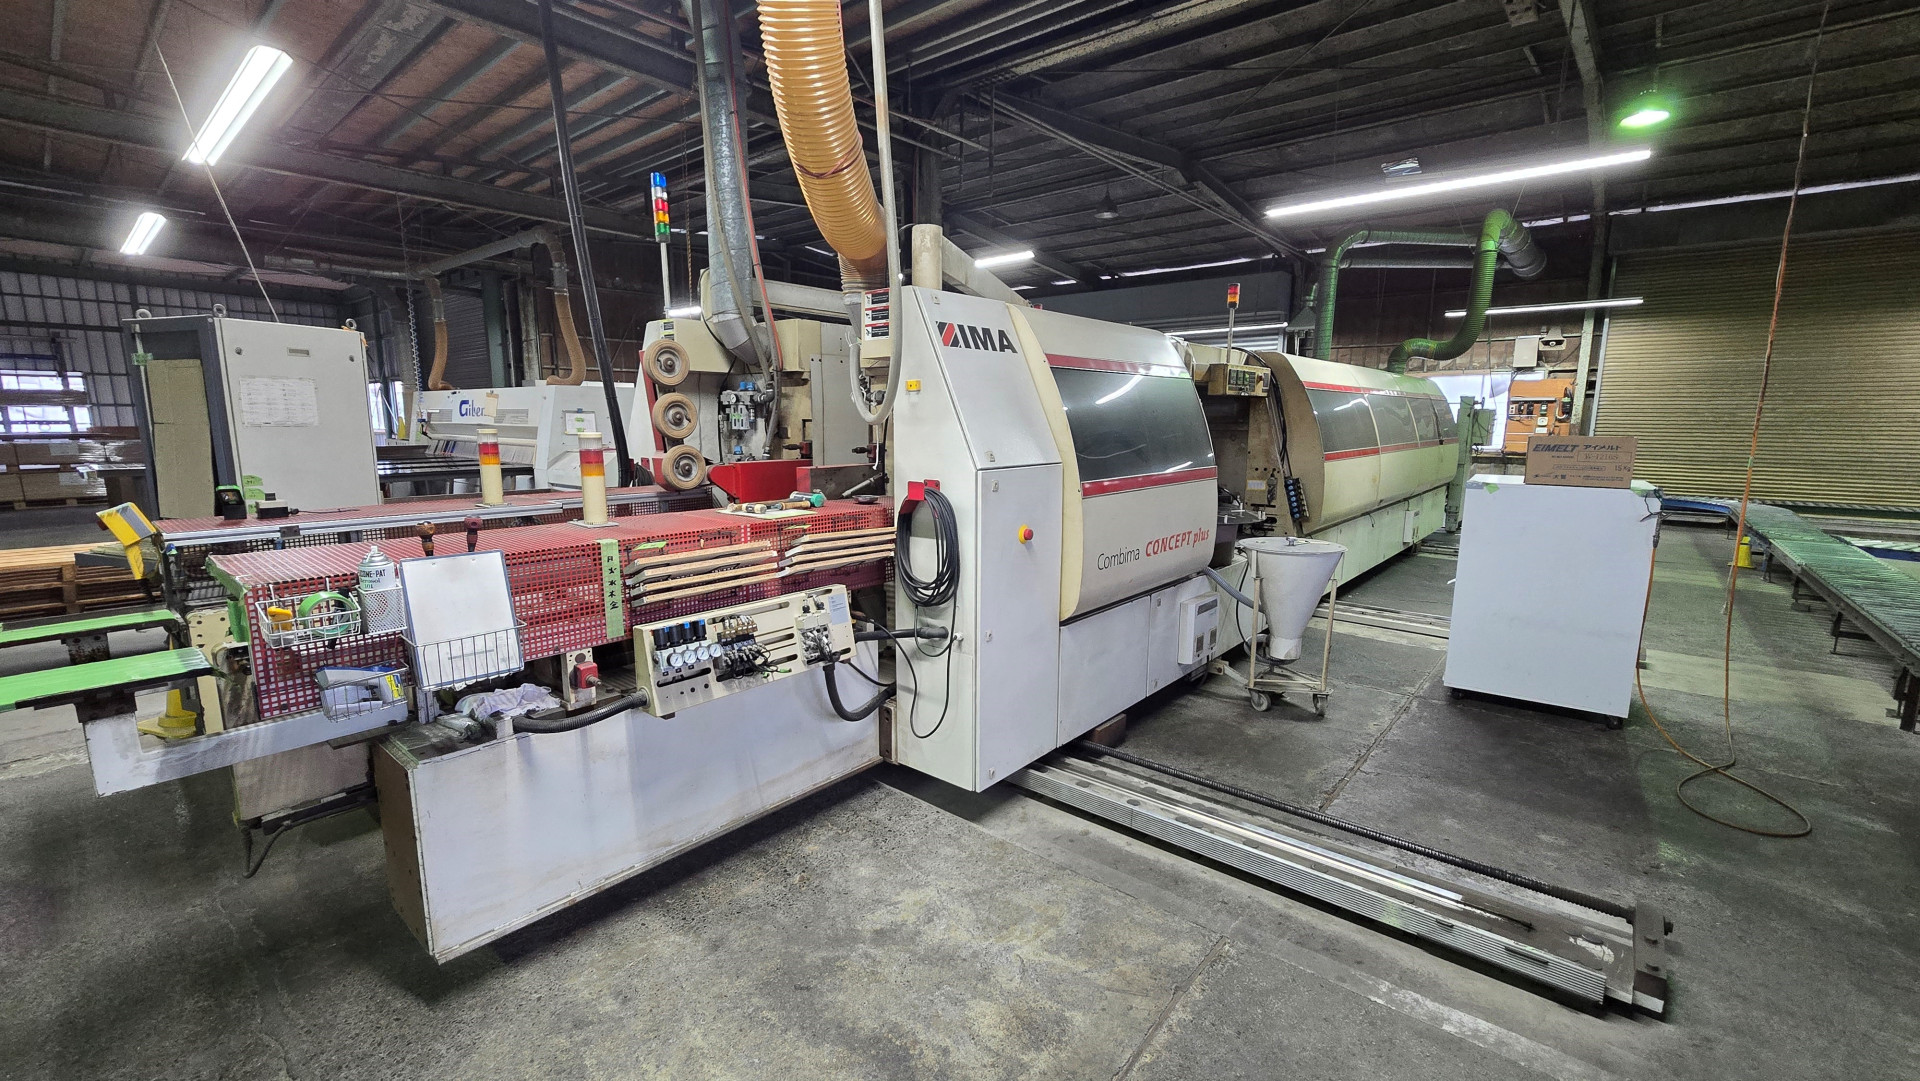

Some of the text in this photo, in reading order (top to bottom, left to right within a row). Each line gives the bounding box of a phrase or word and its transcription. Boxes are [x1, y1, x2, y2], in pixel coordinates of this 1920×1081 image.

[957, 323, 1018, 354] IMA
[1533, 444, 1579, 452] EIMELT
[1098, 527, 1210, 570] Combima CONCEPT plus
